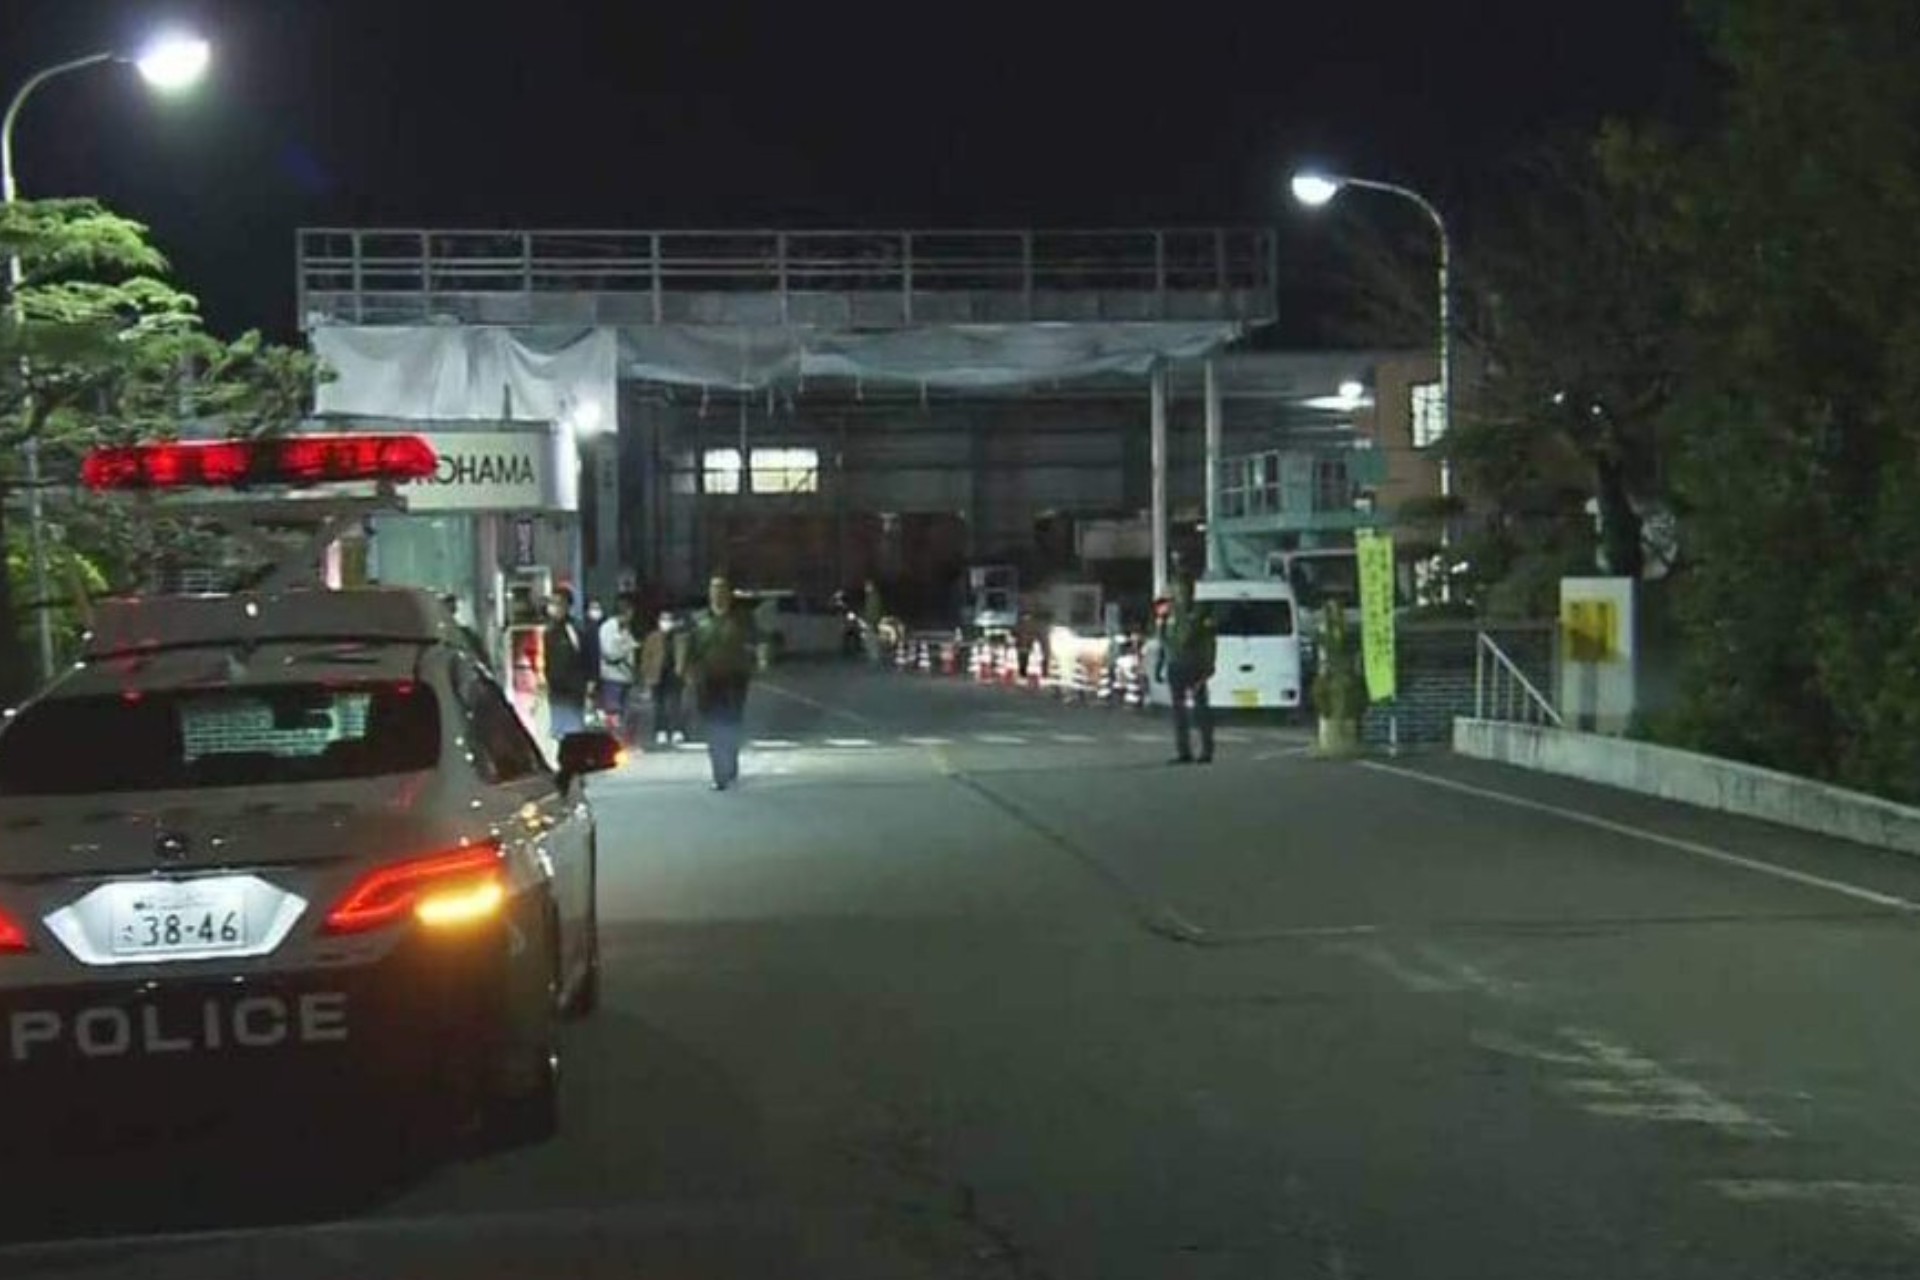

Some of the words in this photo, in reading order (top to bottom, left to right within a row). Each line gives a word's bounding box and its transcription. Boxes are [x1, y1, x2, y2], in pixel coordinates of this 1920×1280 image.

[397, 454, 535, 484] OHAMA
[142, 910, 237, 946] 38-46
[10, 991, 349, 1061] POLICE
